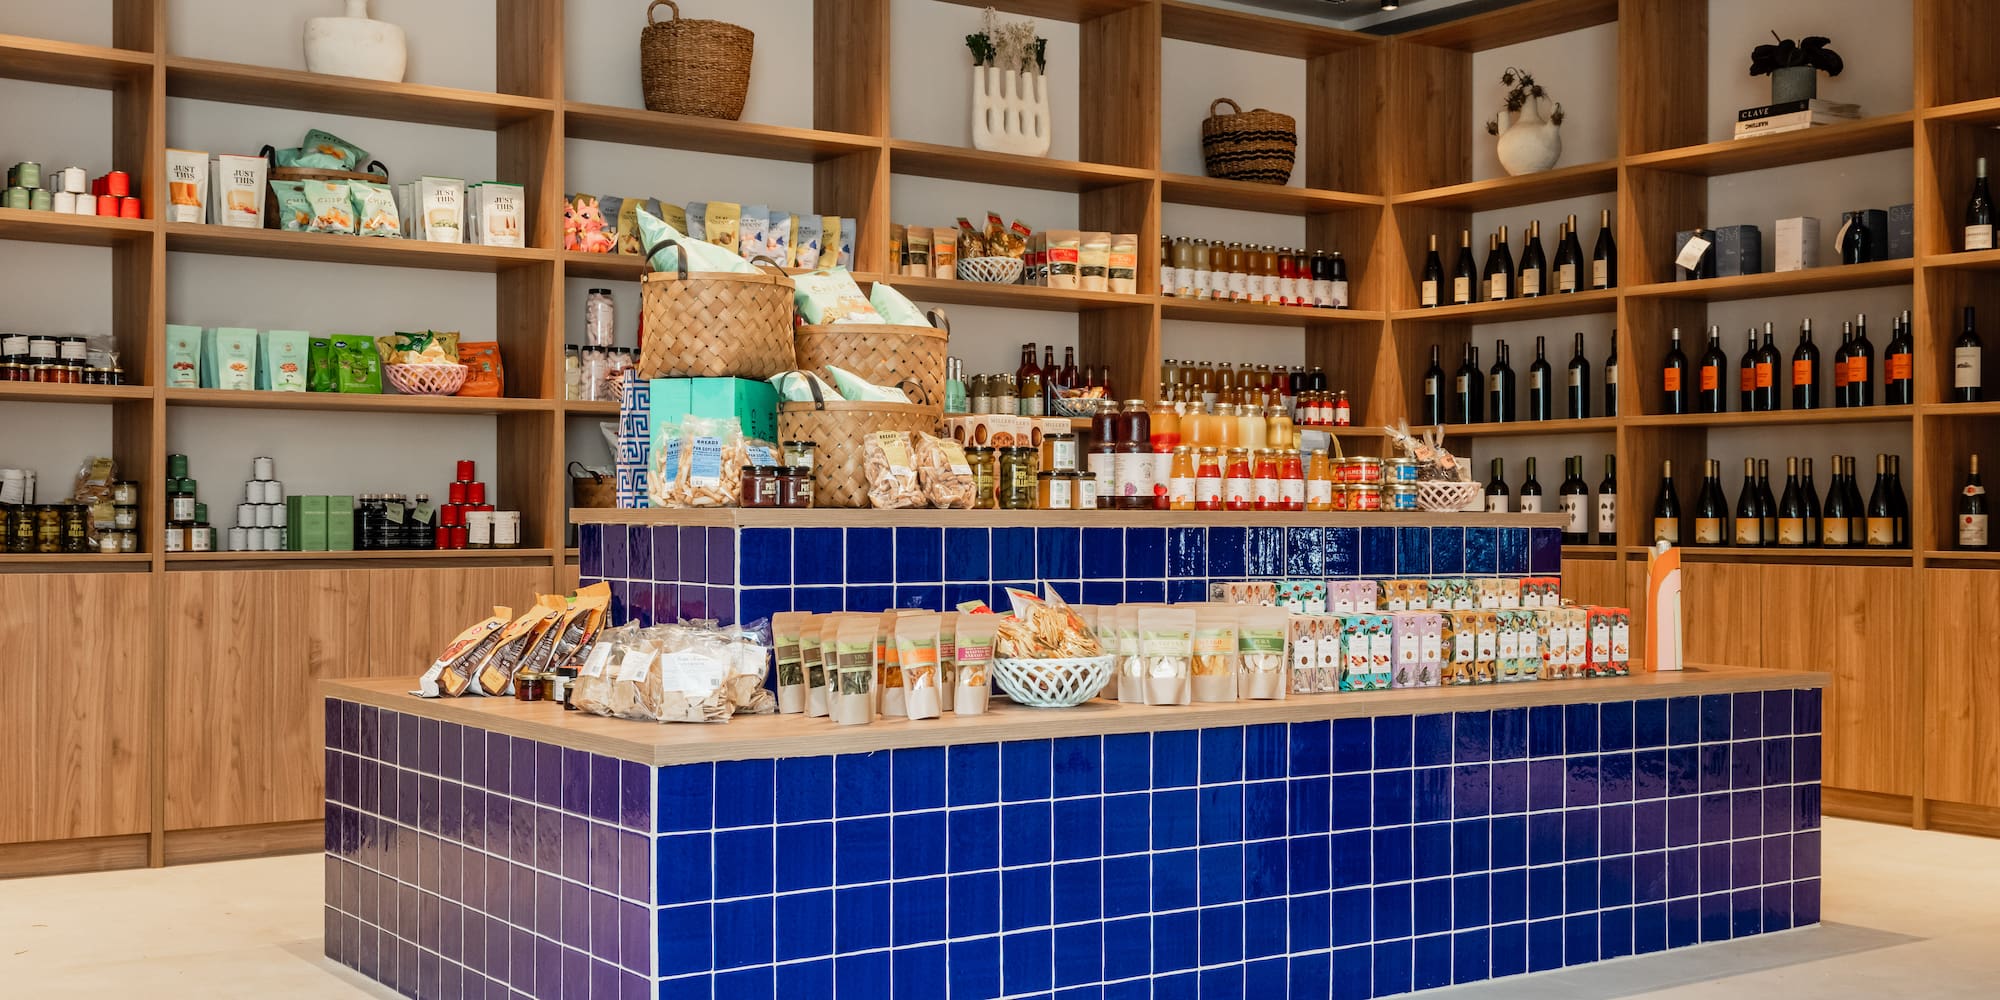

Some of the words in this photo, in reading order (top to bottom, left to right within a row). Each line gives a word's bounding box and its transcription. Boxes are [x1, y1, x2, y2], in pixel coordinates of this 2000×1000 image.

[1742, 107, 1769, 119] CLAVE
[173, 164, 196, 174] JUST
[175, 171, 195, 179] THIS
[233, 169, 256, 178] JUST
[234, 176, 255, 185] THIS
[436, 189, 455, 197] JUST
[437, 195, 455, 203] THIS
[494, 196, 513, 204] JUST
